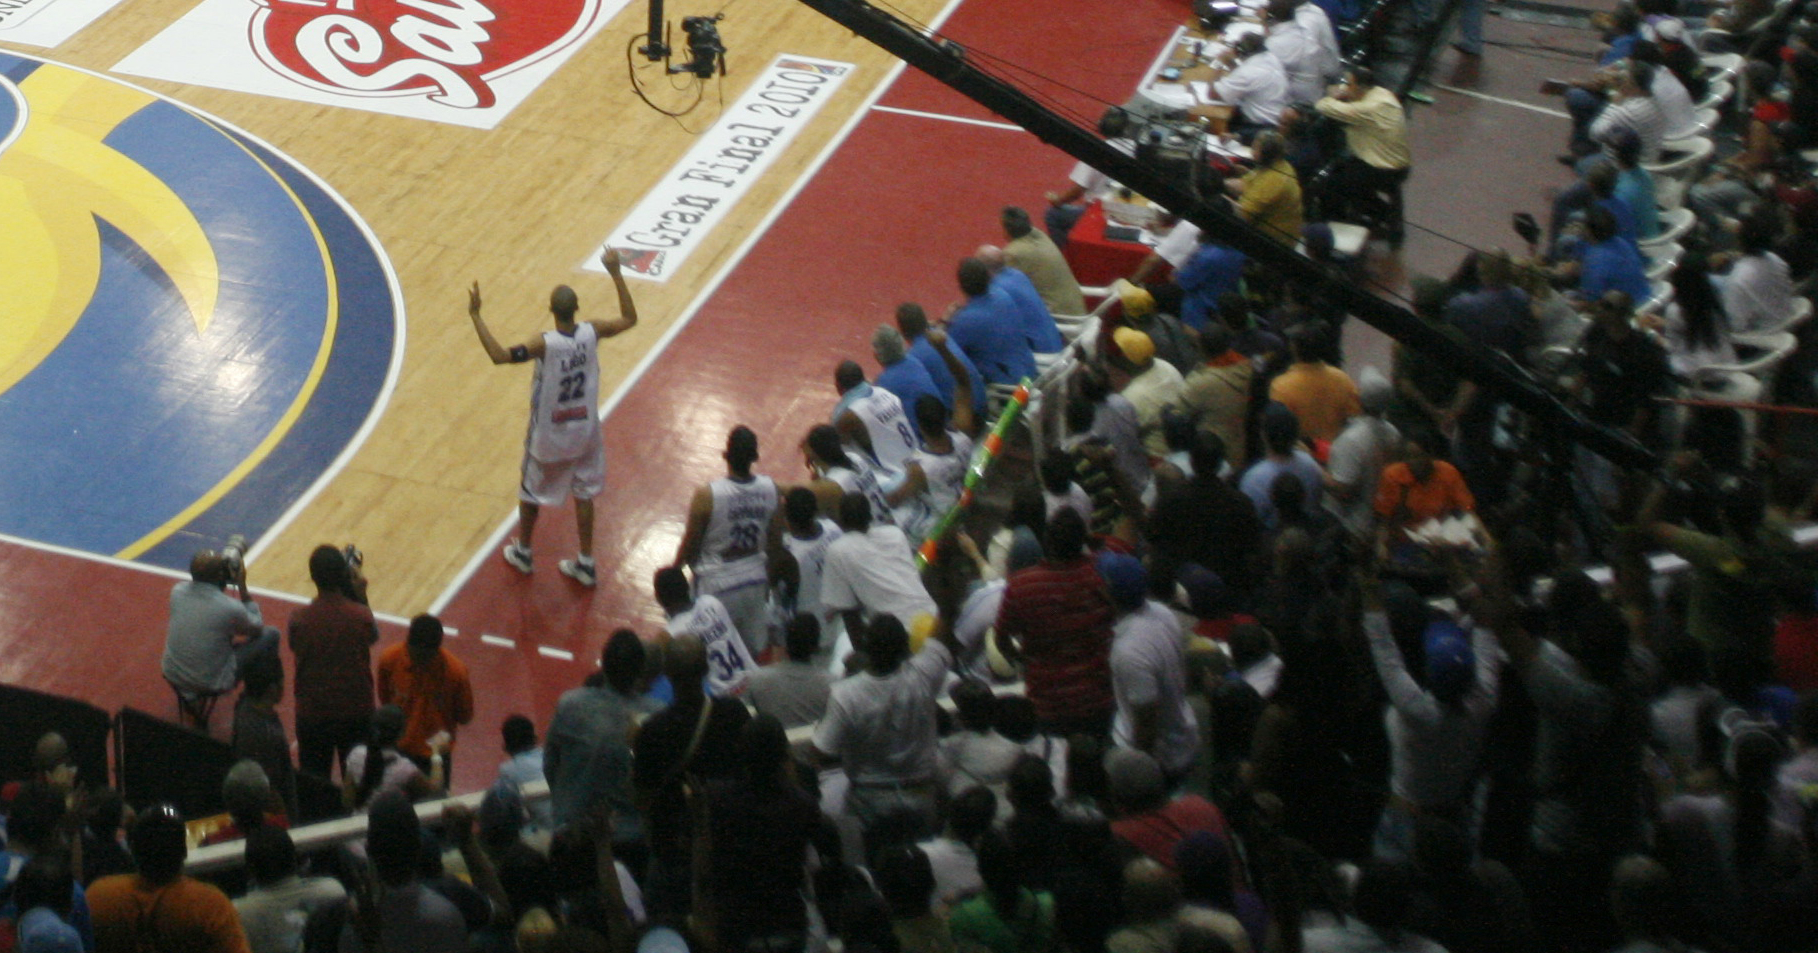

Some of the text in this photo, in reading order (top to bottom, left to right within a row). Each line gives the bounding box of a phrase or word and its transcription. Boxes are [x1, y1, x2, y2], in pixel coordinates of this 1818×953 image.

[625, 70, 828, 248] Gran Final 2010
[558, 371, 586, 402] 22
[897, 421, 914, 448] 8
[709, 639, 745, 680] 34
